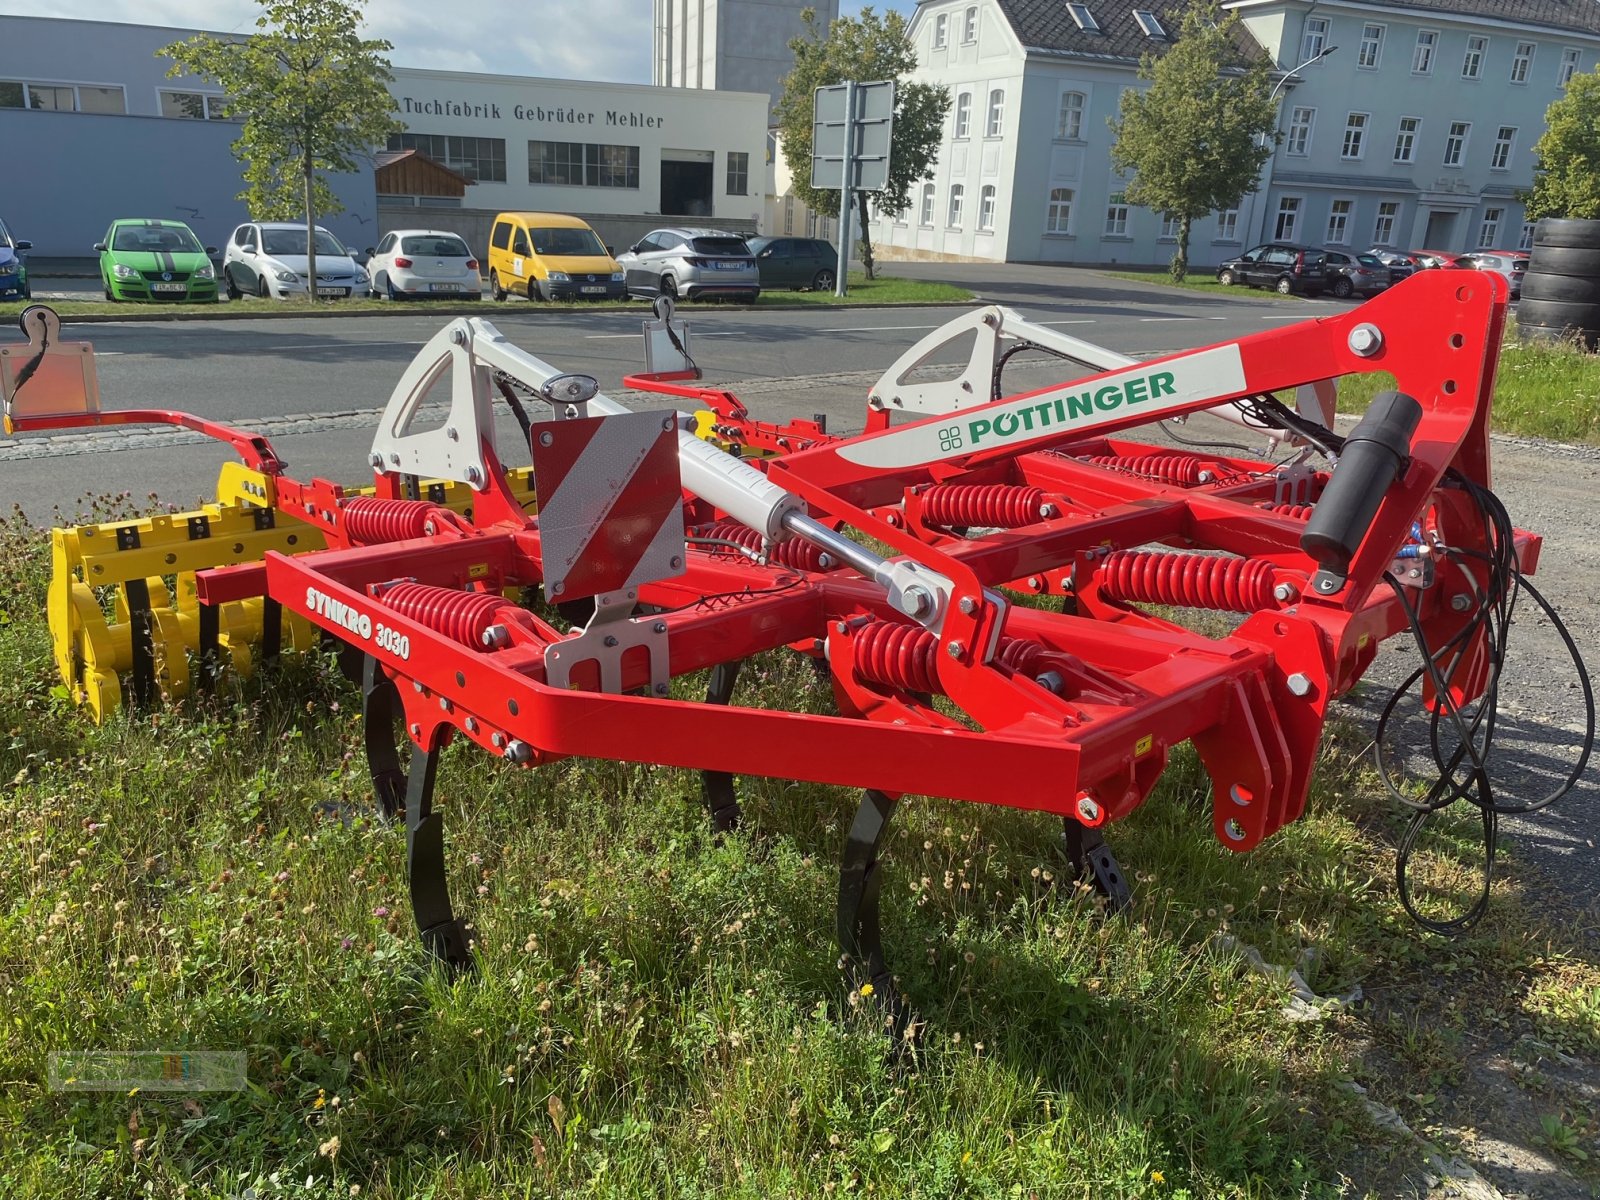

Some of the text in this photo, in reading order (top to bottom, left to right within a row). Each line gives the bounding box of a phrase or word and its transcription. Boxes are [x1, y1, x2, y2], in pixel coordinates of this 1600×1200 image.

[403, 97, 664, 128] Tuchfabrik Gebrüder Mehler
[968, 371, 1177, 445] PÖTTINGER
[306, 586, 410, 661] SYNKRO 3030
